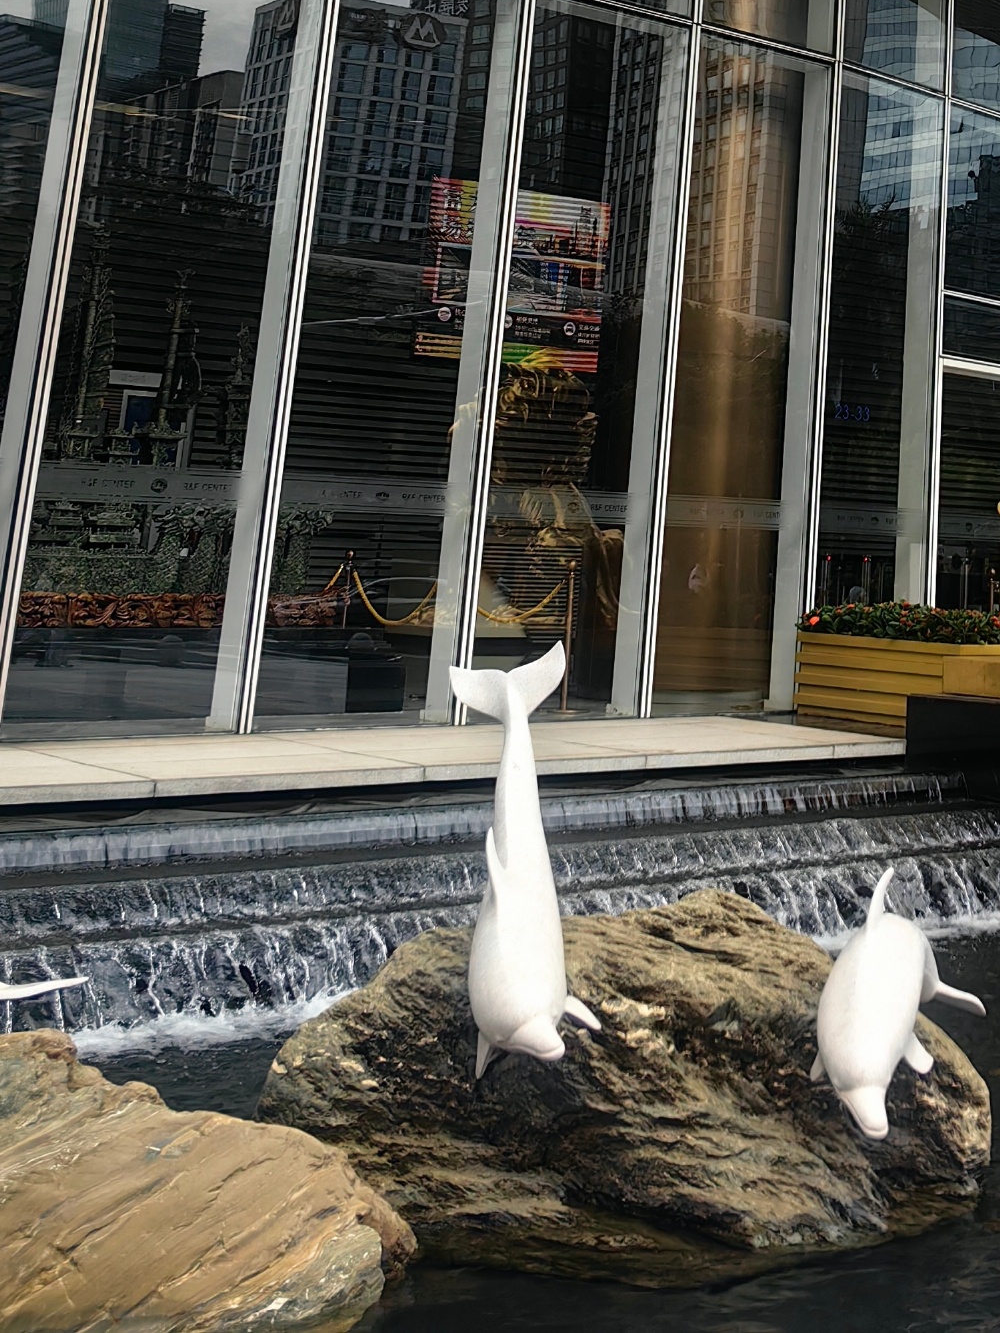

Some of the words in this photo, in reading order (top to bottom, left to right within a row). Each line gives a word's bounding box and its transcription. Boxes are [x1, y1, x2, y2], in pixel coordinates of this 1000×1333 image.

[835, 404, 870, 422] 23-33
[183, 482, 200, 491] R&F
[590, 503, 603, 511] R&F
